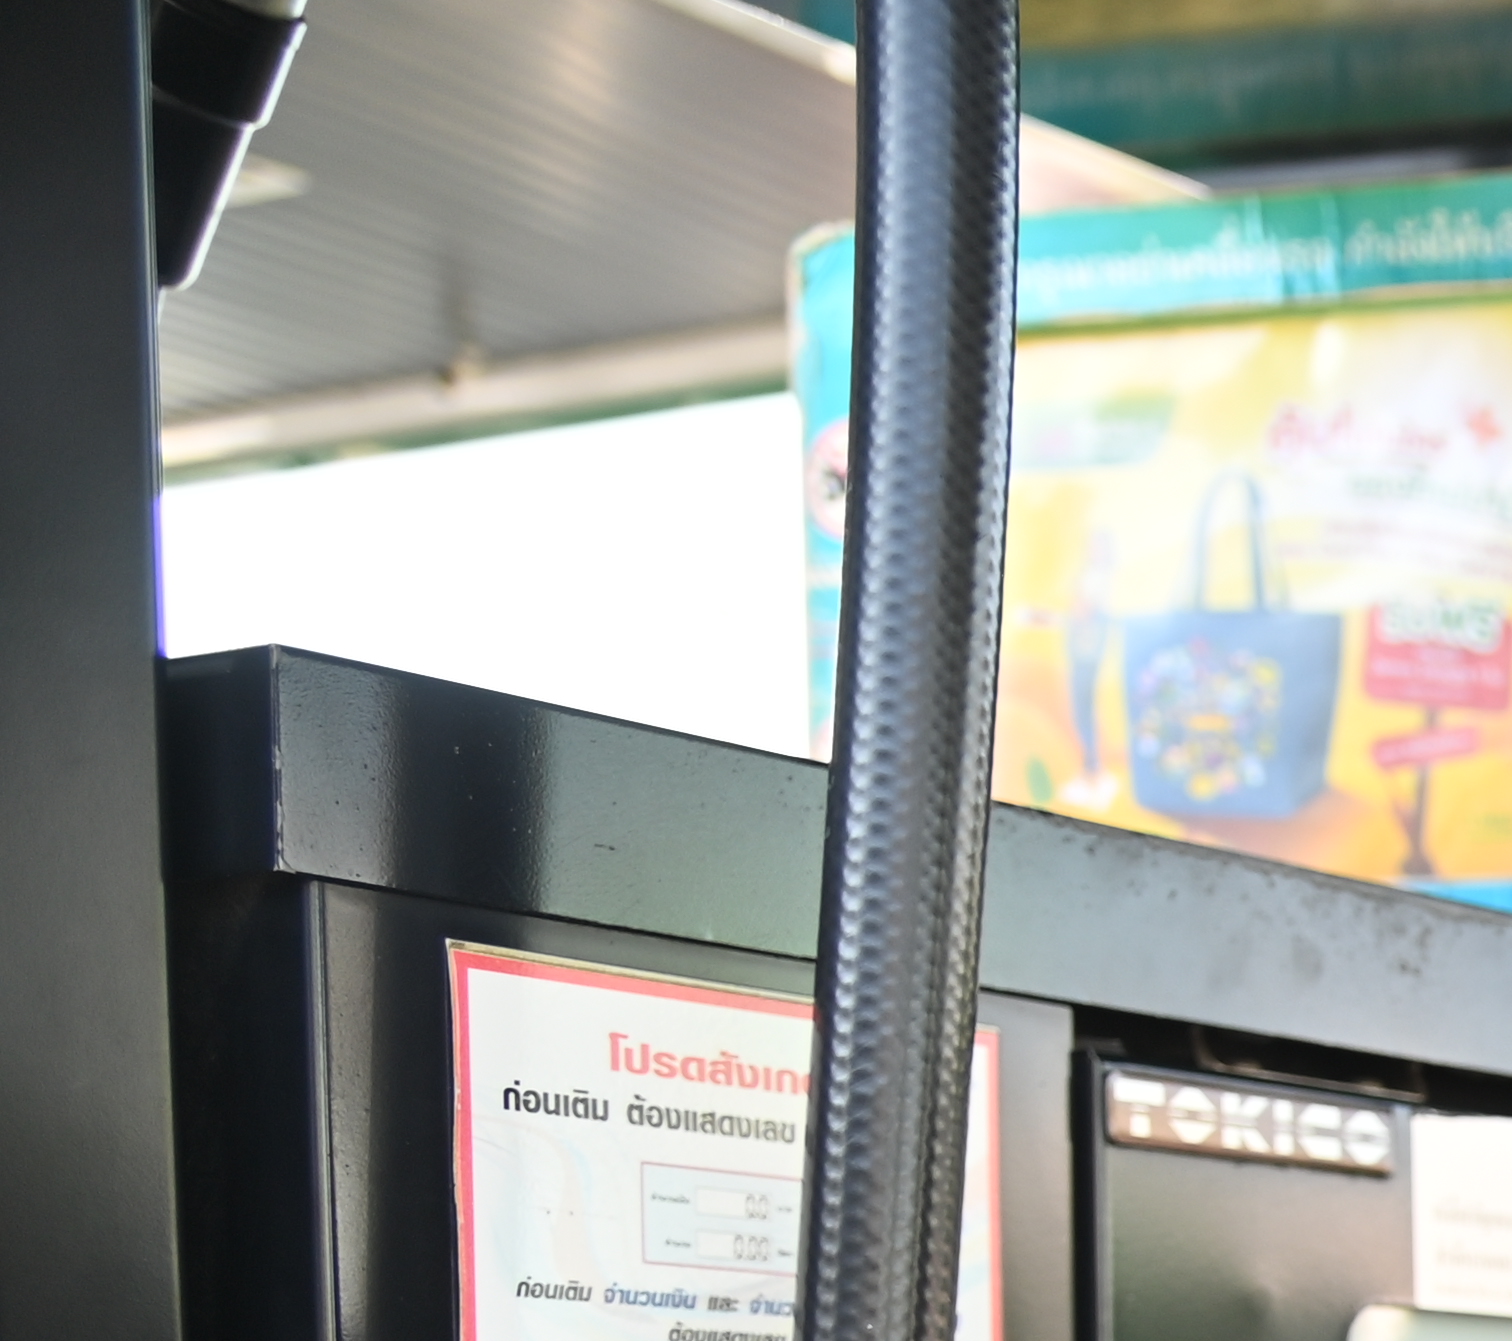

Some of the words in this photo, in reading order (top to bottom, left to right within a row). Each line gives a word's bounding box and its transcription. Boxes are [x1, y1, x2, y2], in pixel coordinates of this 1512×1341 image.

[502, 1080, 609, 1122] ก่อนเติม
[626, 1094, 797, 1144] ต้องแสดงเลข
[1113, 1077, 1391, 1165] TOKICO
[516, 1276, 593, 1302] ก่อนเติม
[603, 1282, 698, 1310] จำนวนเงิน
[707, 1294, 739, 1312] และ
